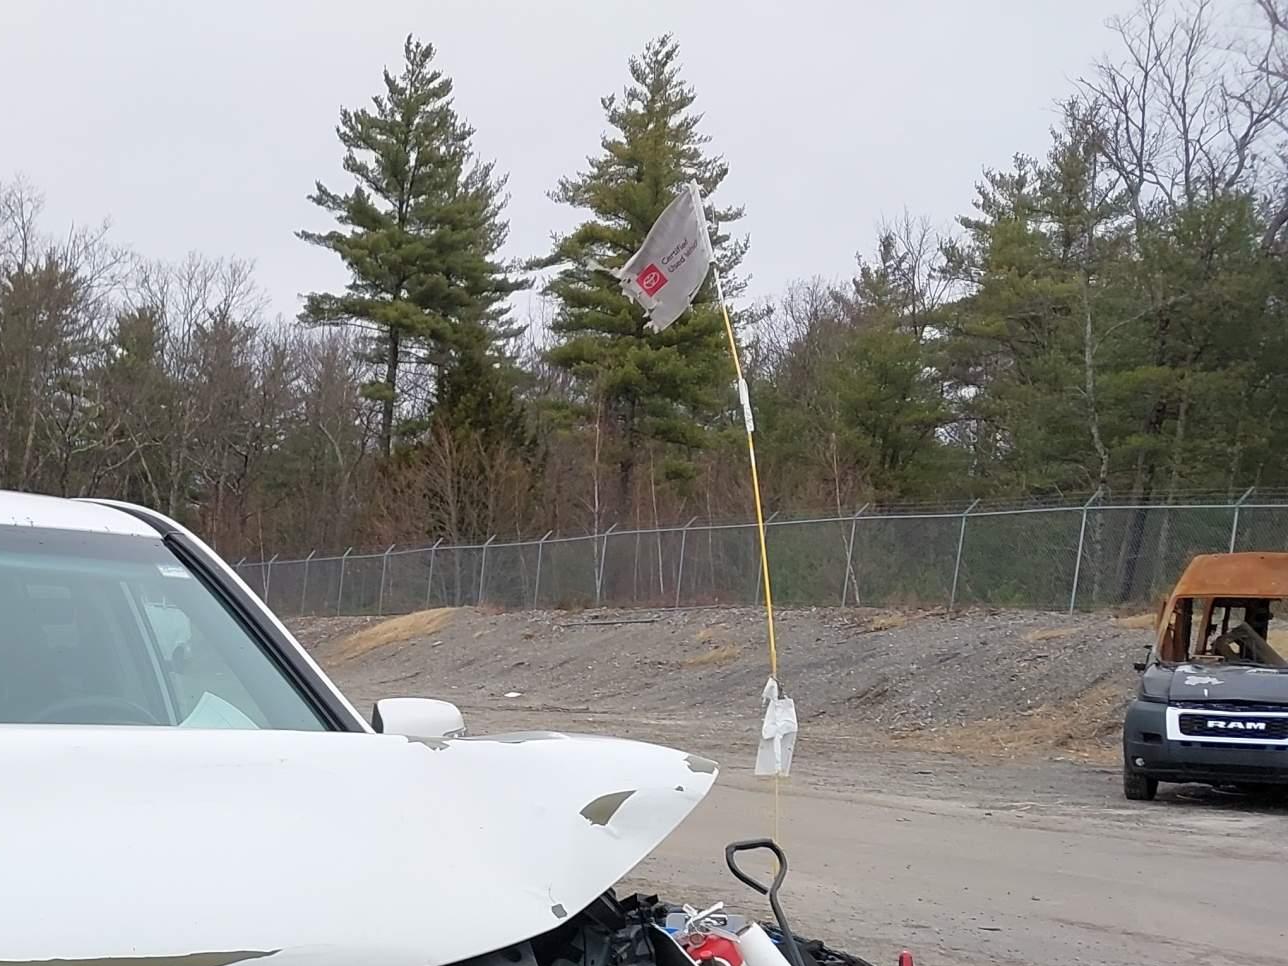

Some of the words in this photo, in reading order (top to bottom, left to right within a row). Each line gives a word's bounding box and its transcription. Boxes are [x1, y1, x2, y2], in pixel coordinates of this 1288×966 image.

[661, 236, 688, 265] Certified
[667, 254, 686, 273] Used
[1207, 720, 1267, 730] RAM
